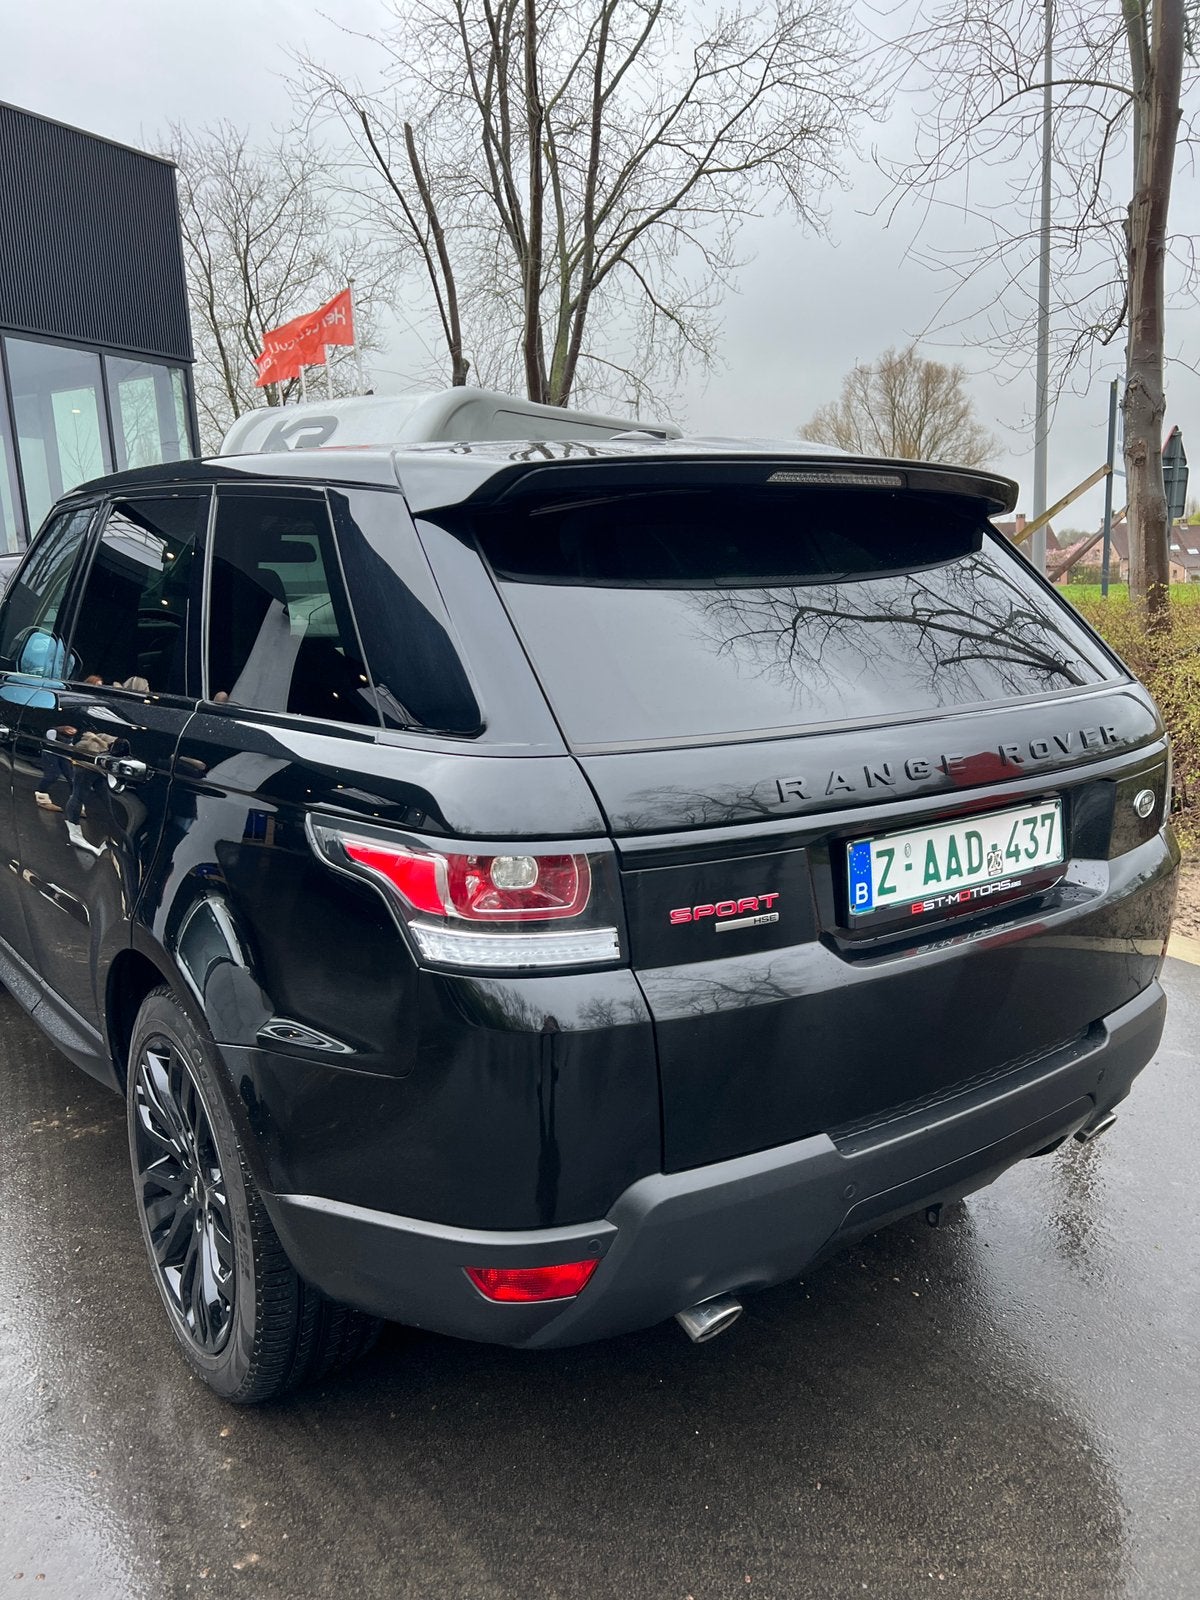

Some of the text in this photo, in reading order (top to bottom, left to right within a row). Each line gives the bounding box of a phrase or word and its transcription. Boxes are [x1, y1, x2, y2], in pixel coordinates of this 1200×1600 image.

[775, 725, 1122, 803] RANGE ROVER
[875, 812, 1056, 897] Z-AAD-437
[670, 892, 780, 925] SPORT
[855, 882, 869, 905] B
[753, 914, 778, 925] HSE
